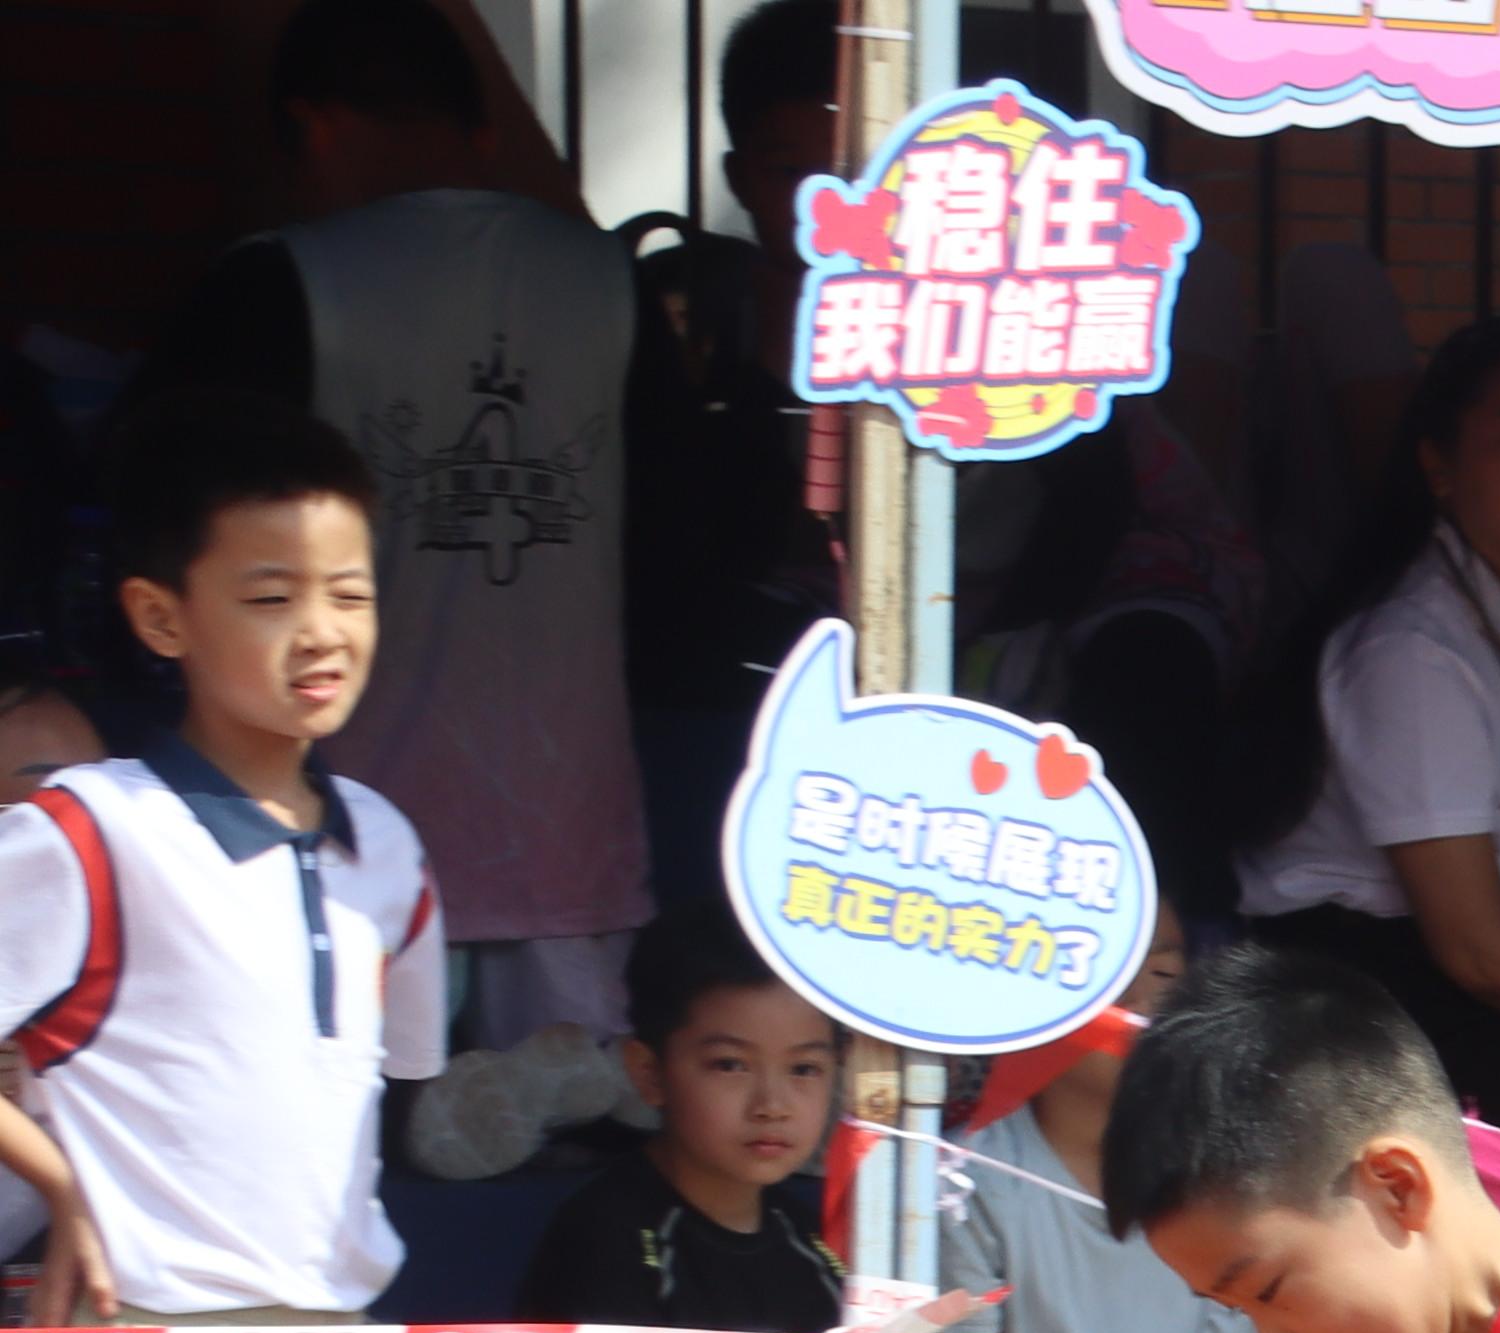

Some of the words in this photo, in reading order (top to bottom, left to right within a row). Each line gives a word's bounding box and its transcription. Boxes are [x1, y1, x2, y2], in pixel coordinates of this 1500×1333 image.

[893, 140, 1131, 277] 稳住
[808, 272, 1160, 383] 我们能赢
[788, 770, 1121, 913] 是时候展现
[777, 859, 1101, 990] 真正的实力了
